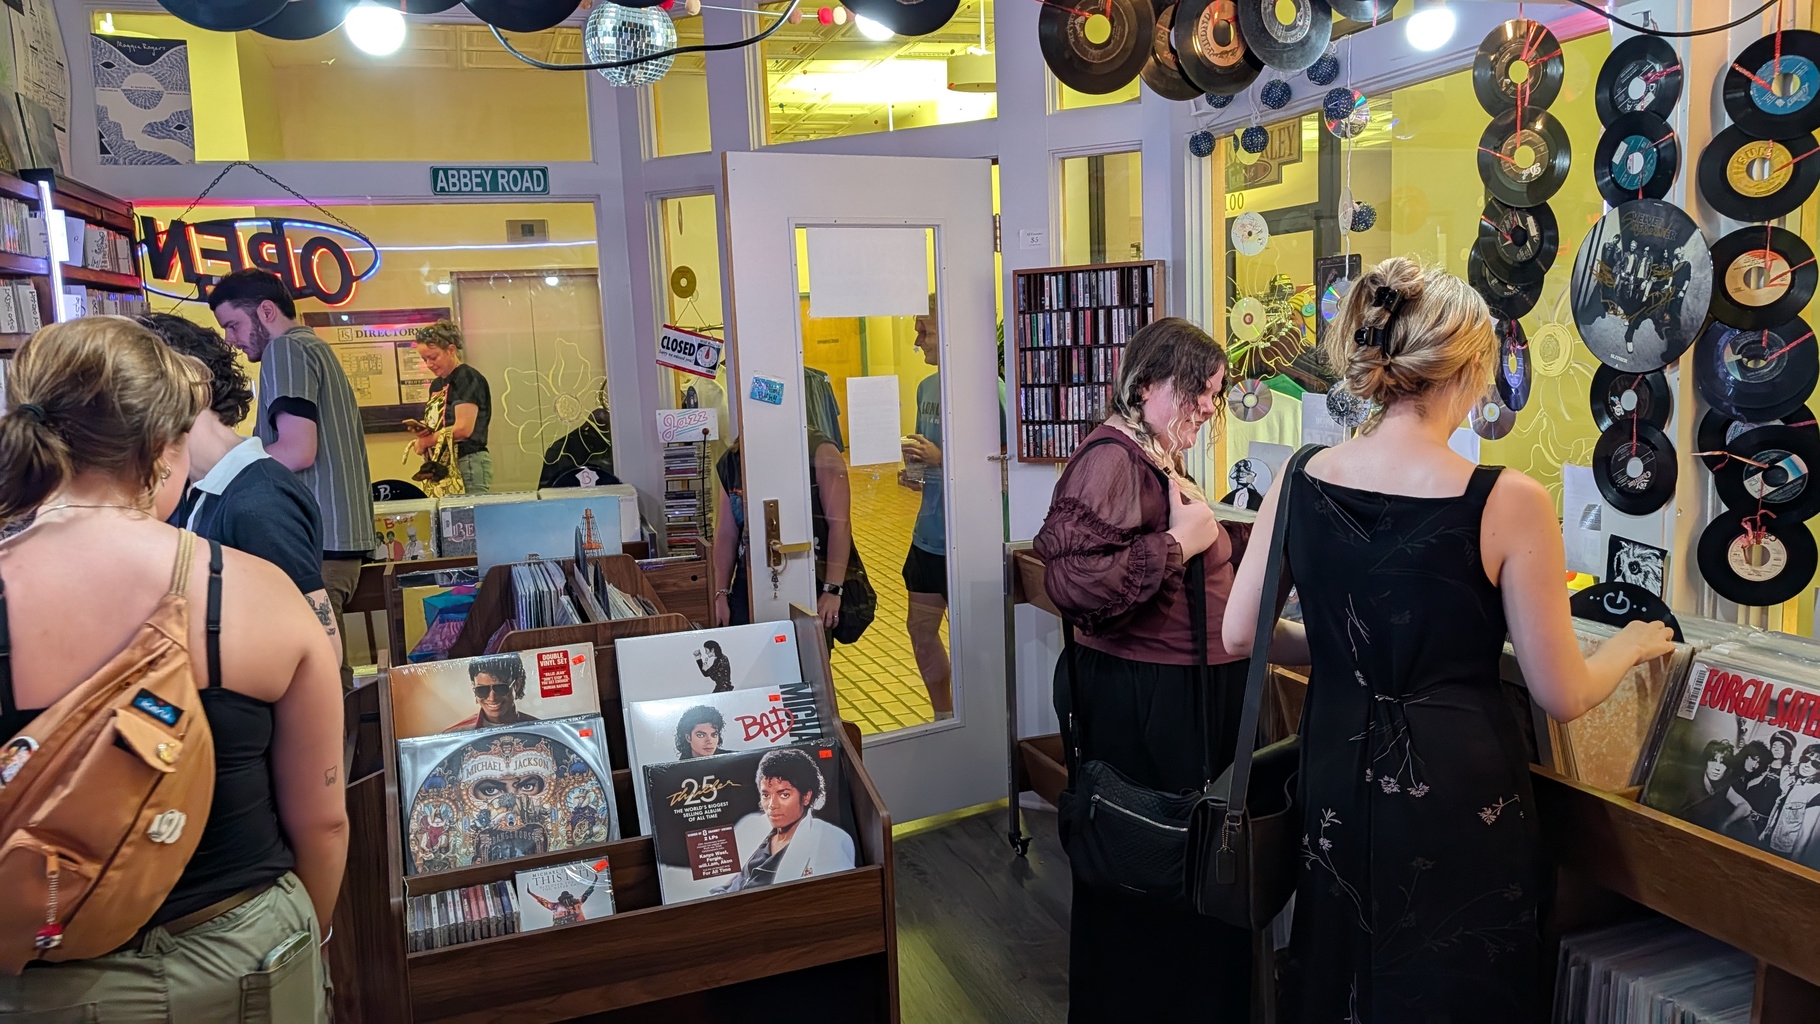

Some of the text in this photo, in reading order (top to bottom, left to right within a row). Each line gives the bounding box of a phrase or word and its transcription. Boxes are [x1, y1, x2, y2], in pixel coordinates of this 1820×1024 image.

[116, 40, 167, 57] Maggie Rogers
[1737, 146, 1774, 165] SUN
[435, 169, 545, 193] ABBEY ROAD
[355, 326, 423, 339] DIRECTORY
[661, 335, 696, 357] CLOSED
[661, 410, 708, 442] Jazz
[581, 470, 592, 485] B
[377, 484, 392, 501] B
[1236, 492, 1246, 508] C
[540, 659, 556, 667] VINYL
[542, 652, 564, 661] DOUBLE
[734, 706, 795, 743] BAD
[466, 757, 549, 777] MICHAEL JACKSON
[681, 774, 718, 806] 25
[682, 807, 722, 818] SELLING ALBUM
[683, 804, 708, 813] WORLD'S
[708, 801, 729, 809] BIGGEST
[532, 874, 562, 886] THIS
